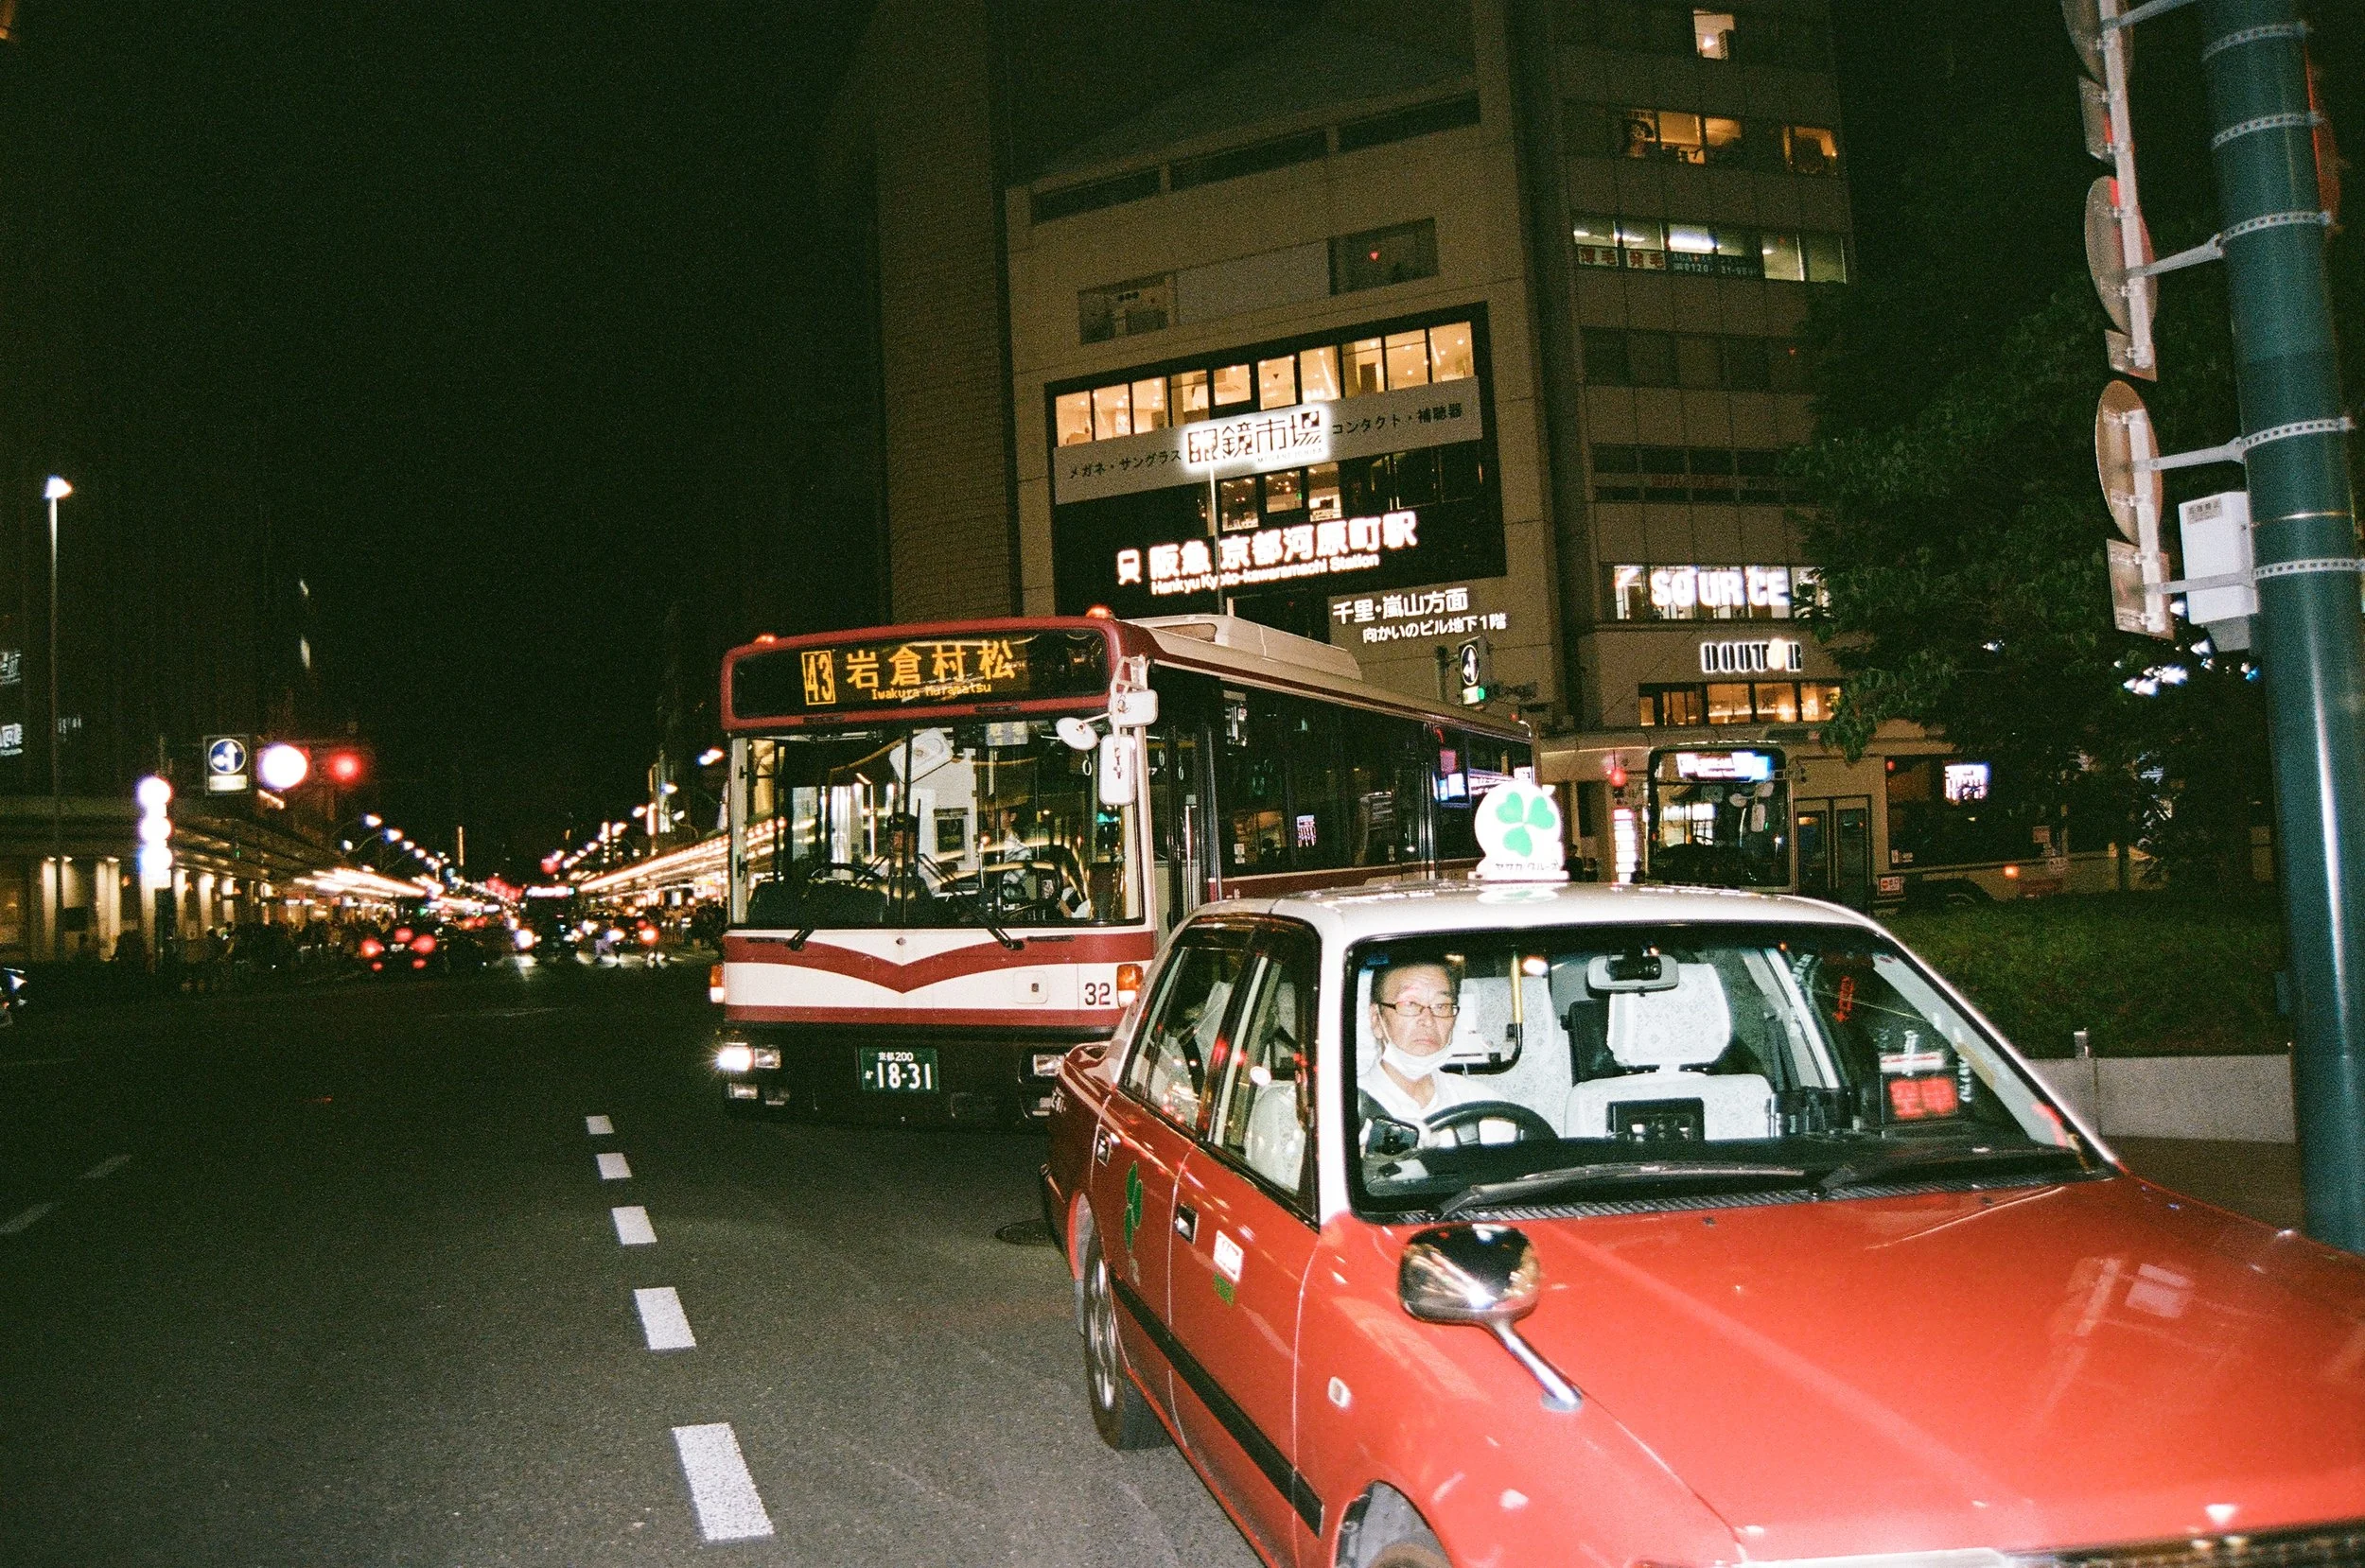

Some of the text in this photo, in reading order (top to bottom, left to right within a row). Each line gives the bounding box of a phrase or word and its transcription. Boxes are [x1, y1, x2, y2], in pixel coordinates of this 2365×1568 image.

[1187, 410, 1323, 464] 眼鏡市場
[1069, 449, 1182, 479] メガネ・サングラス
[1218, 511, 1418, 569] 京都河原町駅
[1329, 553, 1379, 573] Station
[1650, 570, 1791, 607] SOURCE
[1333, 587, 1468, 624] 千里・嵐山方面
[1363, 613, 1507, 643] 向かいのビル地下1階
[806, 640, 1016, 703] 43 岩倉村松
[1701, 637, 1802, 673] DOUTOR
[871, 687, 920, 701] Iwakura
[1084, 982, 1112, 1006] 32
[877, 1062, 932, 1089] 18-31
